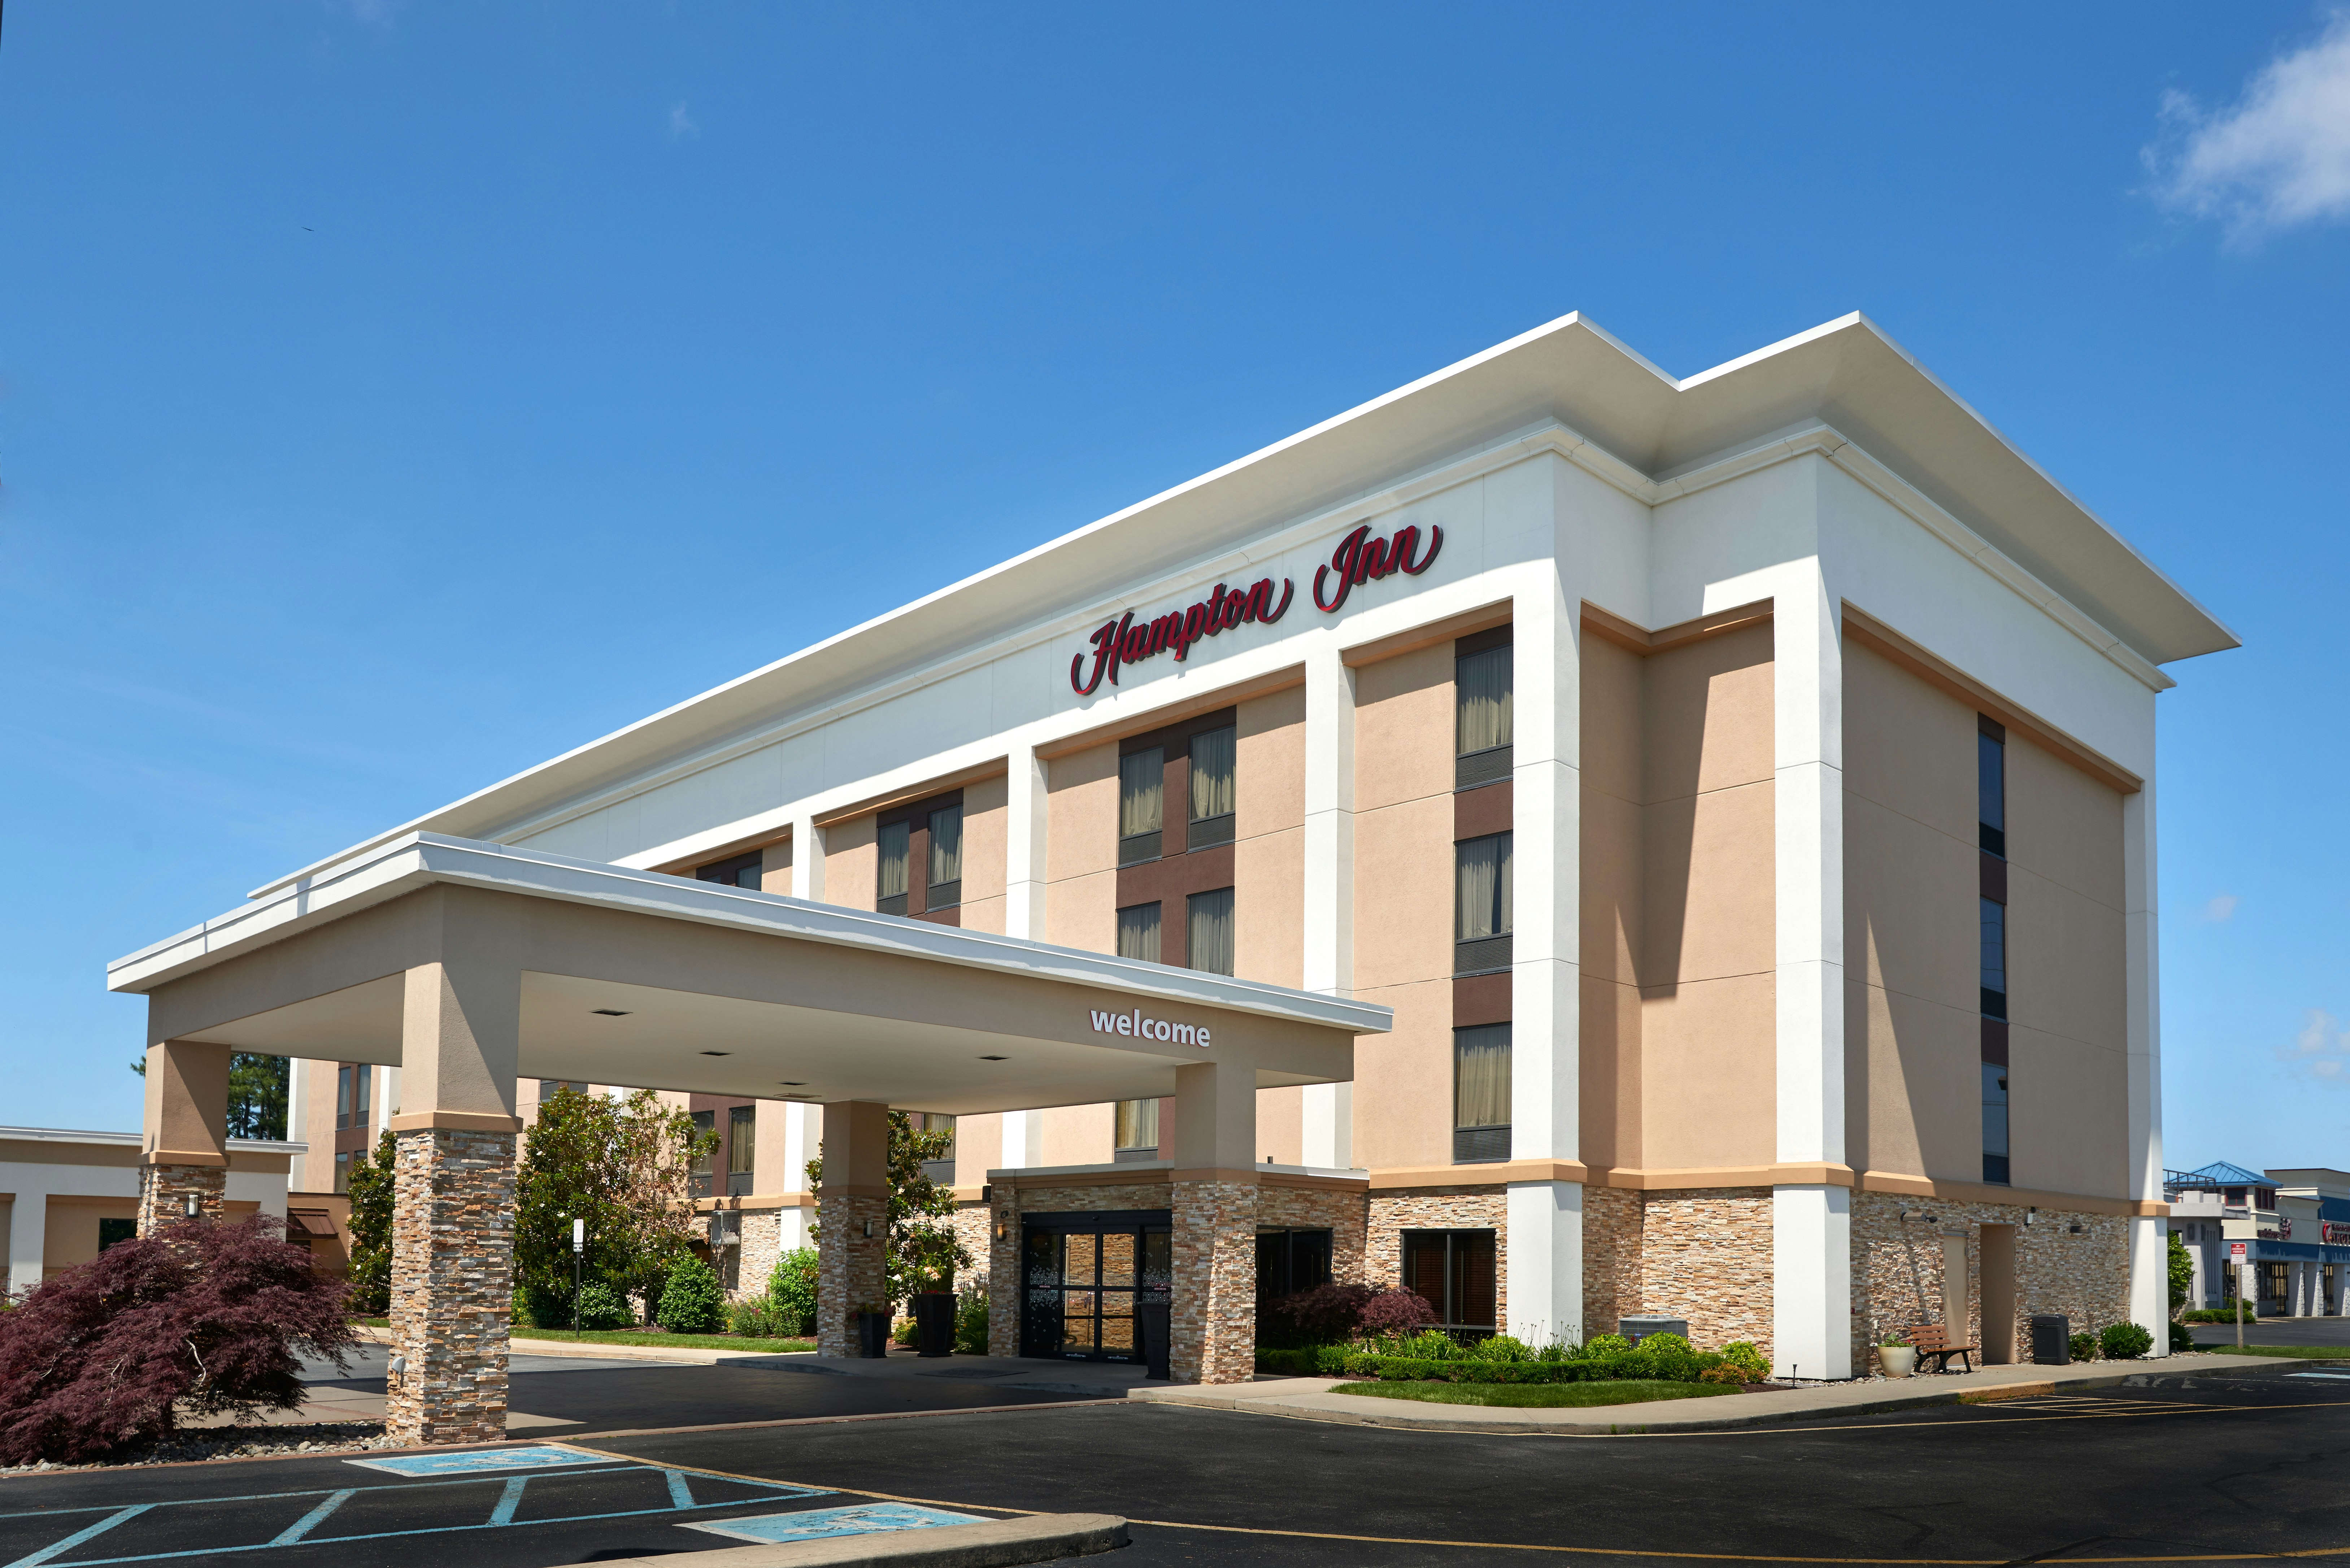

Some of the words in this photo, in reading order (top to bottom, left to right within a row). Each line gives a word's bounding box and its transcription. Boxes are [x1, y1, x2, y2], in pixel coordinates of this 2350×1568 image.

[1070, 578, 1294, 696] Hampton
[1313, 525, 1443, 613] Inn
[1090, 1009, 1210, 1047] welcome
